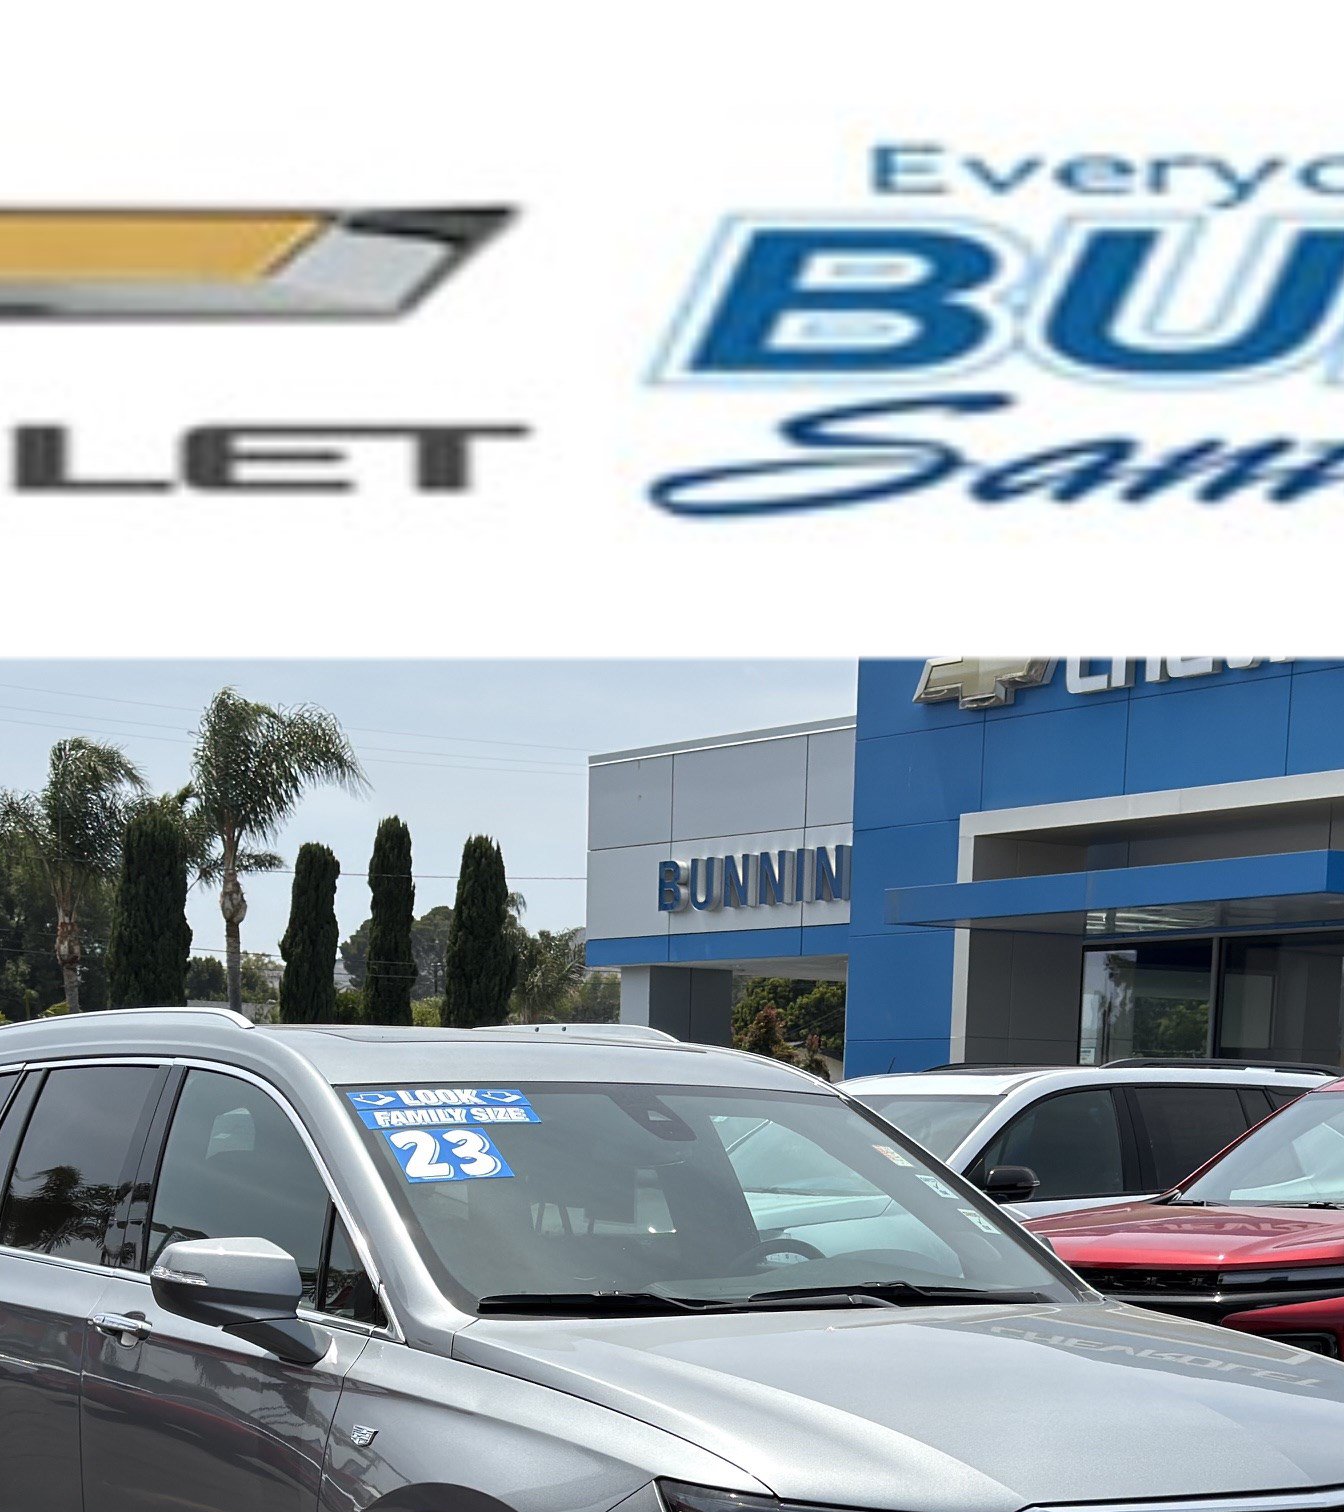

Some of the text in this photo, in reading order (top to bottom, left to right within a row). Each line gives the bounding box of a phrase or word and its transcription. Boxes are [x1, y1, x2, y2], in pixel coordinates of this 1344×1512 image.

[658, 844, 852, 914] BUNNIN
[396, 1088, 487, 1107] LOOK
[373, 1106, 530, 1127] FAMILY SIZE
[389, 1128, 503, 1180] 23
